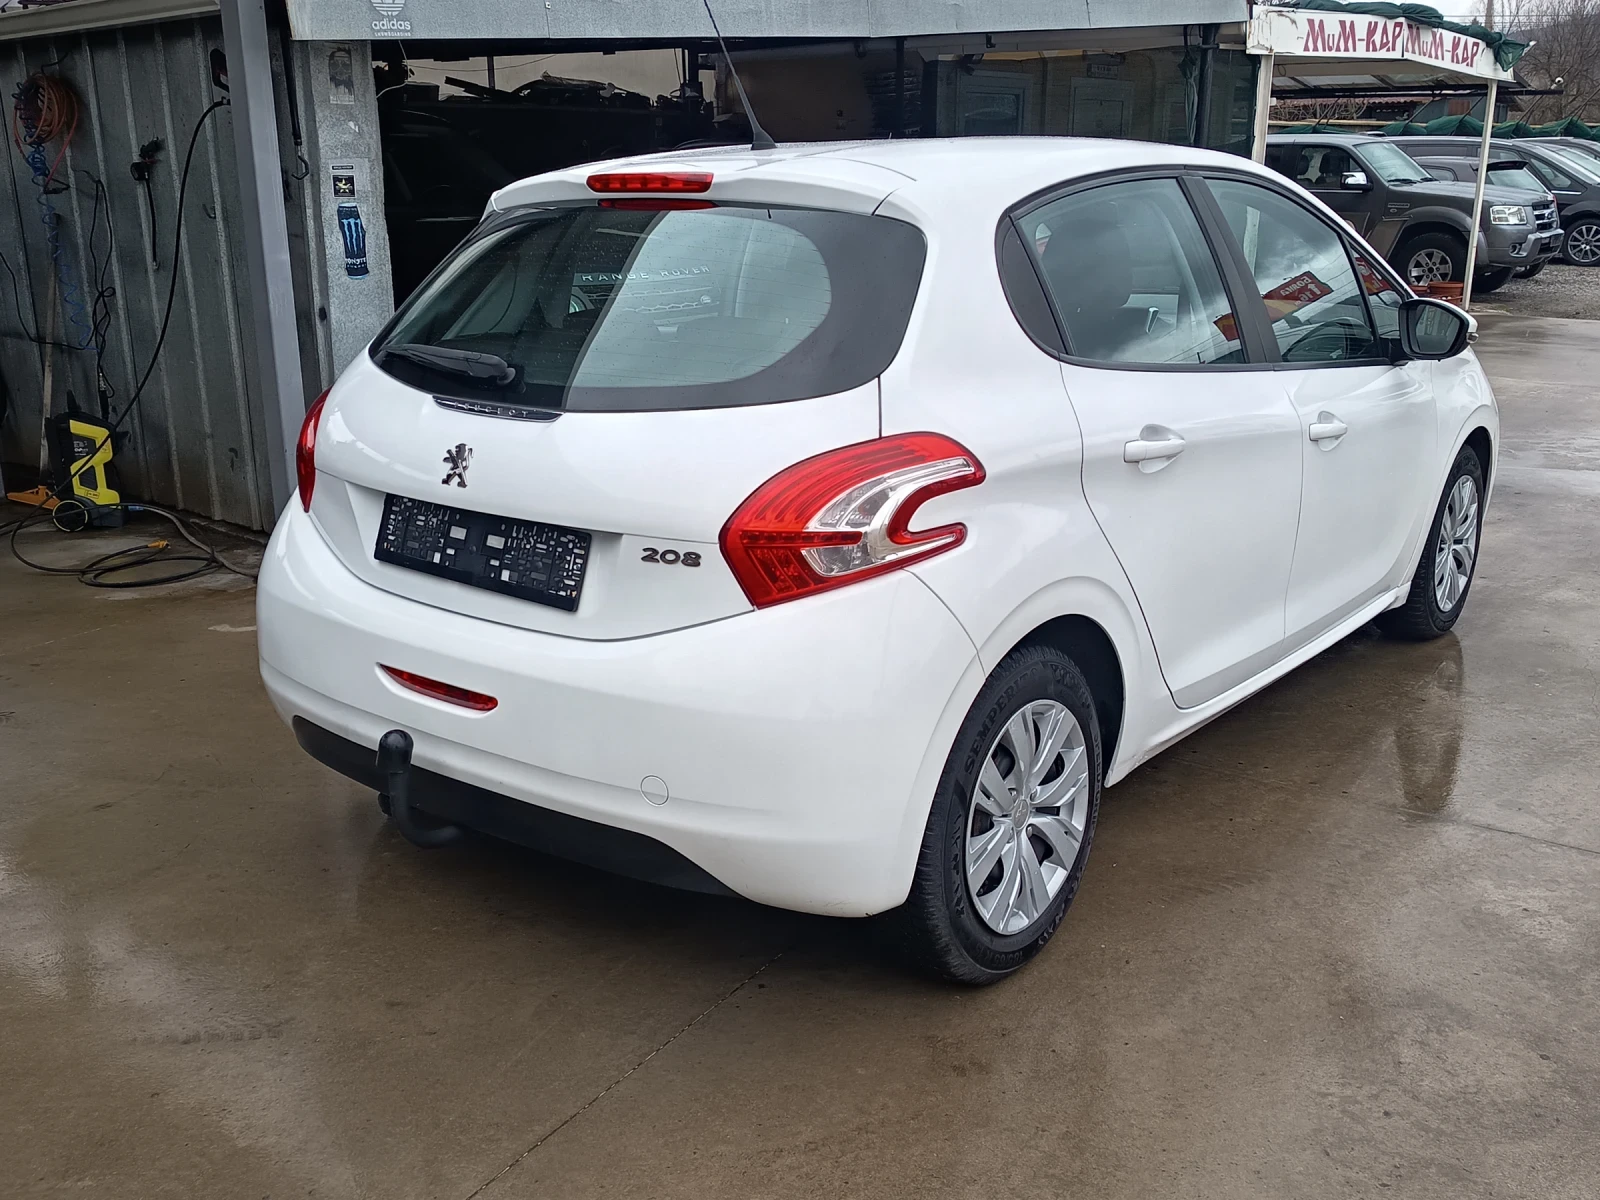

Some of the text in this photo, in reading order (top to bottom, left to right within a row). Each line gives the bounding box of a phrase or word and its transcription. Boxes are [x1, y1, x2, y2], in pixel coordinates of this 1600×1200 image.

[371, 18, 411, 30] adidas
[581, 265, 710, 282] RANGE ROVER
[641, 547, 702, 568] 208
